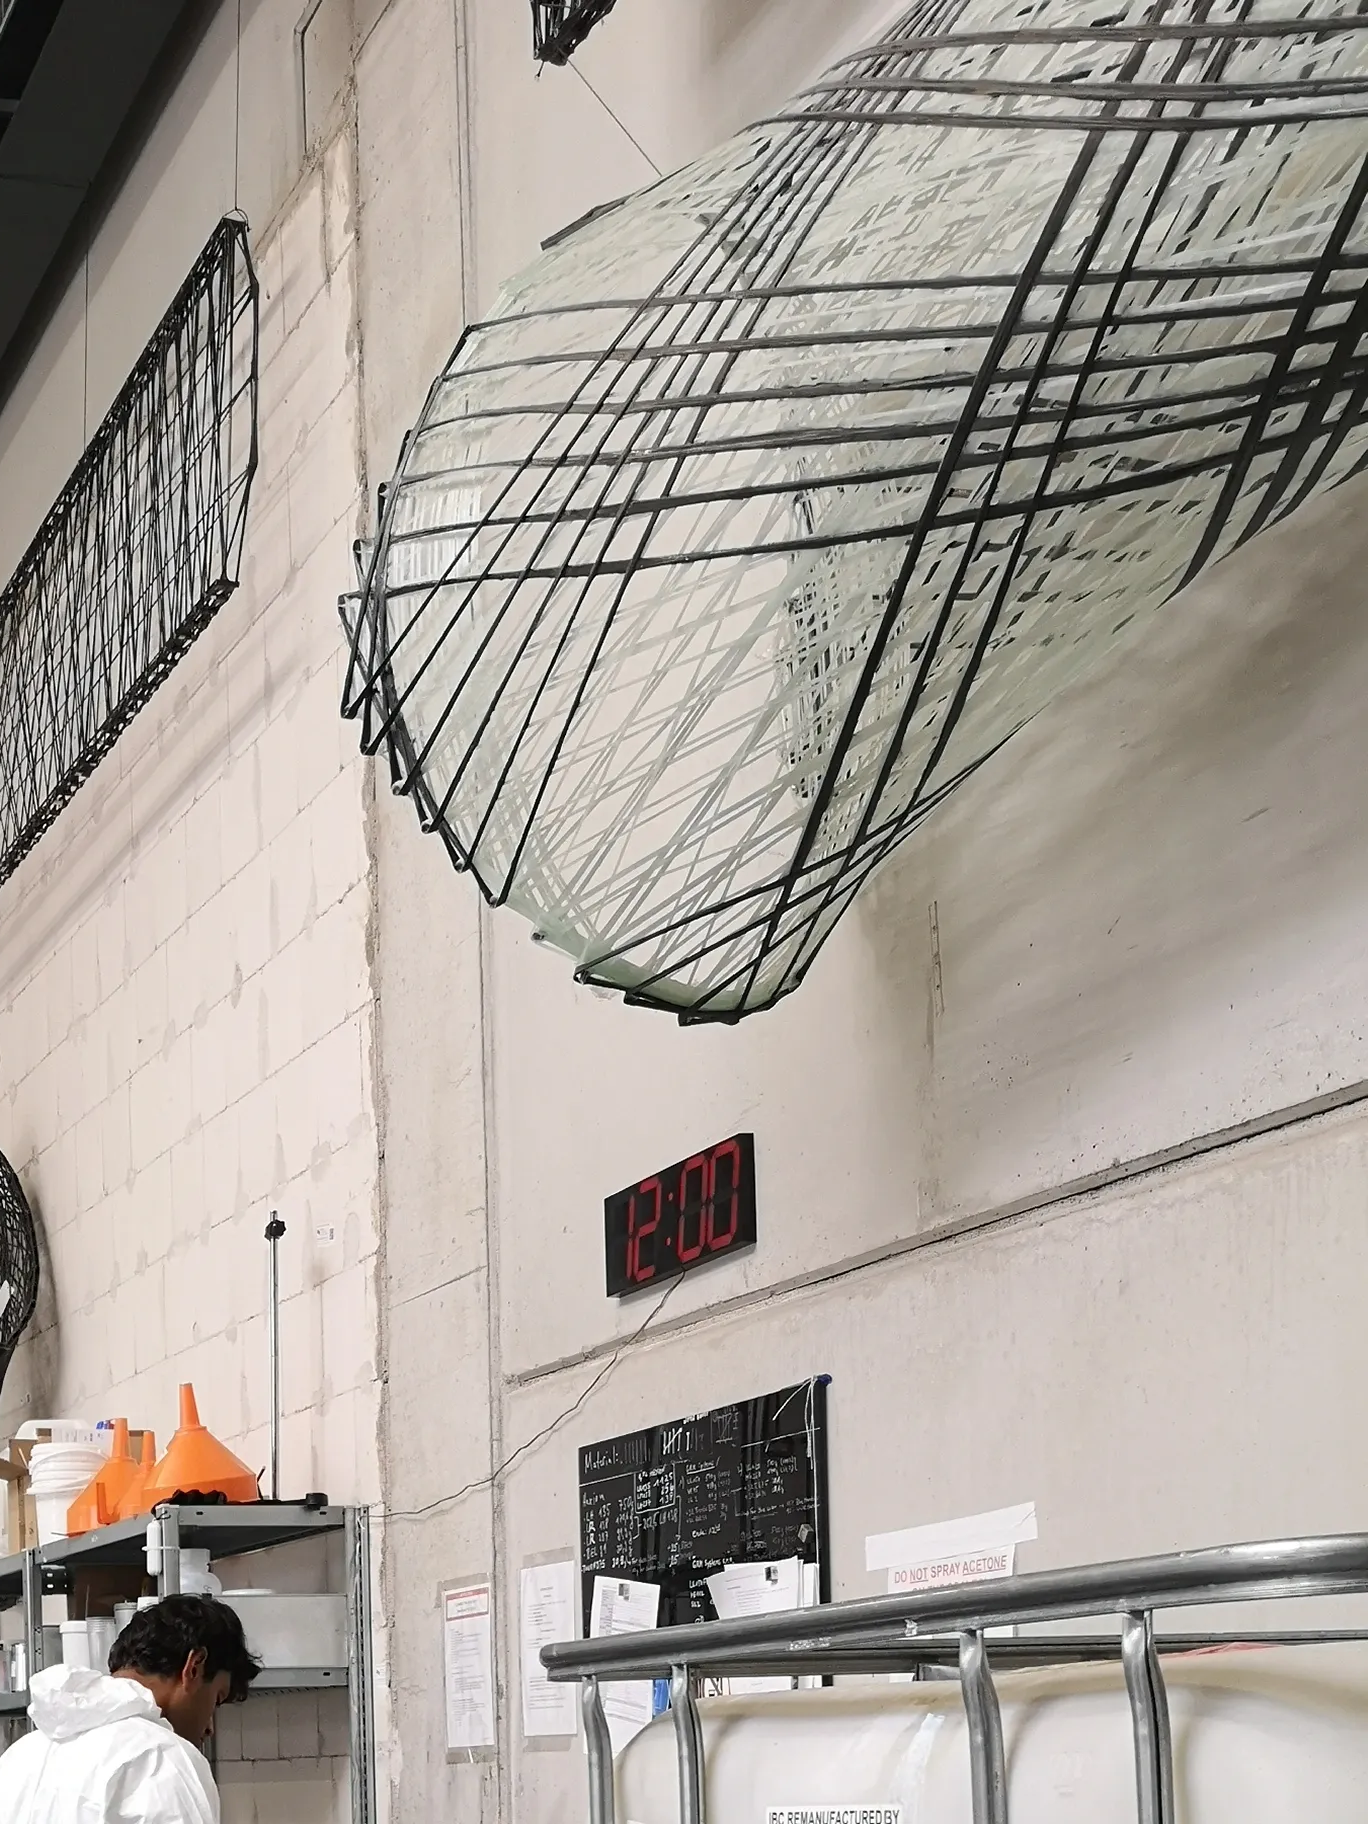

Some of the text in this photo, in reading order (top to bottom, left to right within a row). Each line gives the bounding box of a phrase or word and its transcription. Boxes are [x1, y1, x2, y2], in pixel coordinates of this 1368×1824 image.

[626, 1139, 740, 1281] 12:00
[894, 1570, 907, 1584] DO
[910, 1567, 928, 1582] NOT
[930, 1561, 961, 1578] SPRAY
[962, 1555, 1007, 1574] ACETONE
